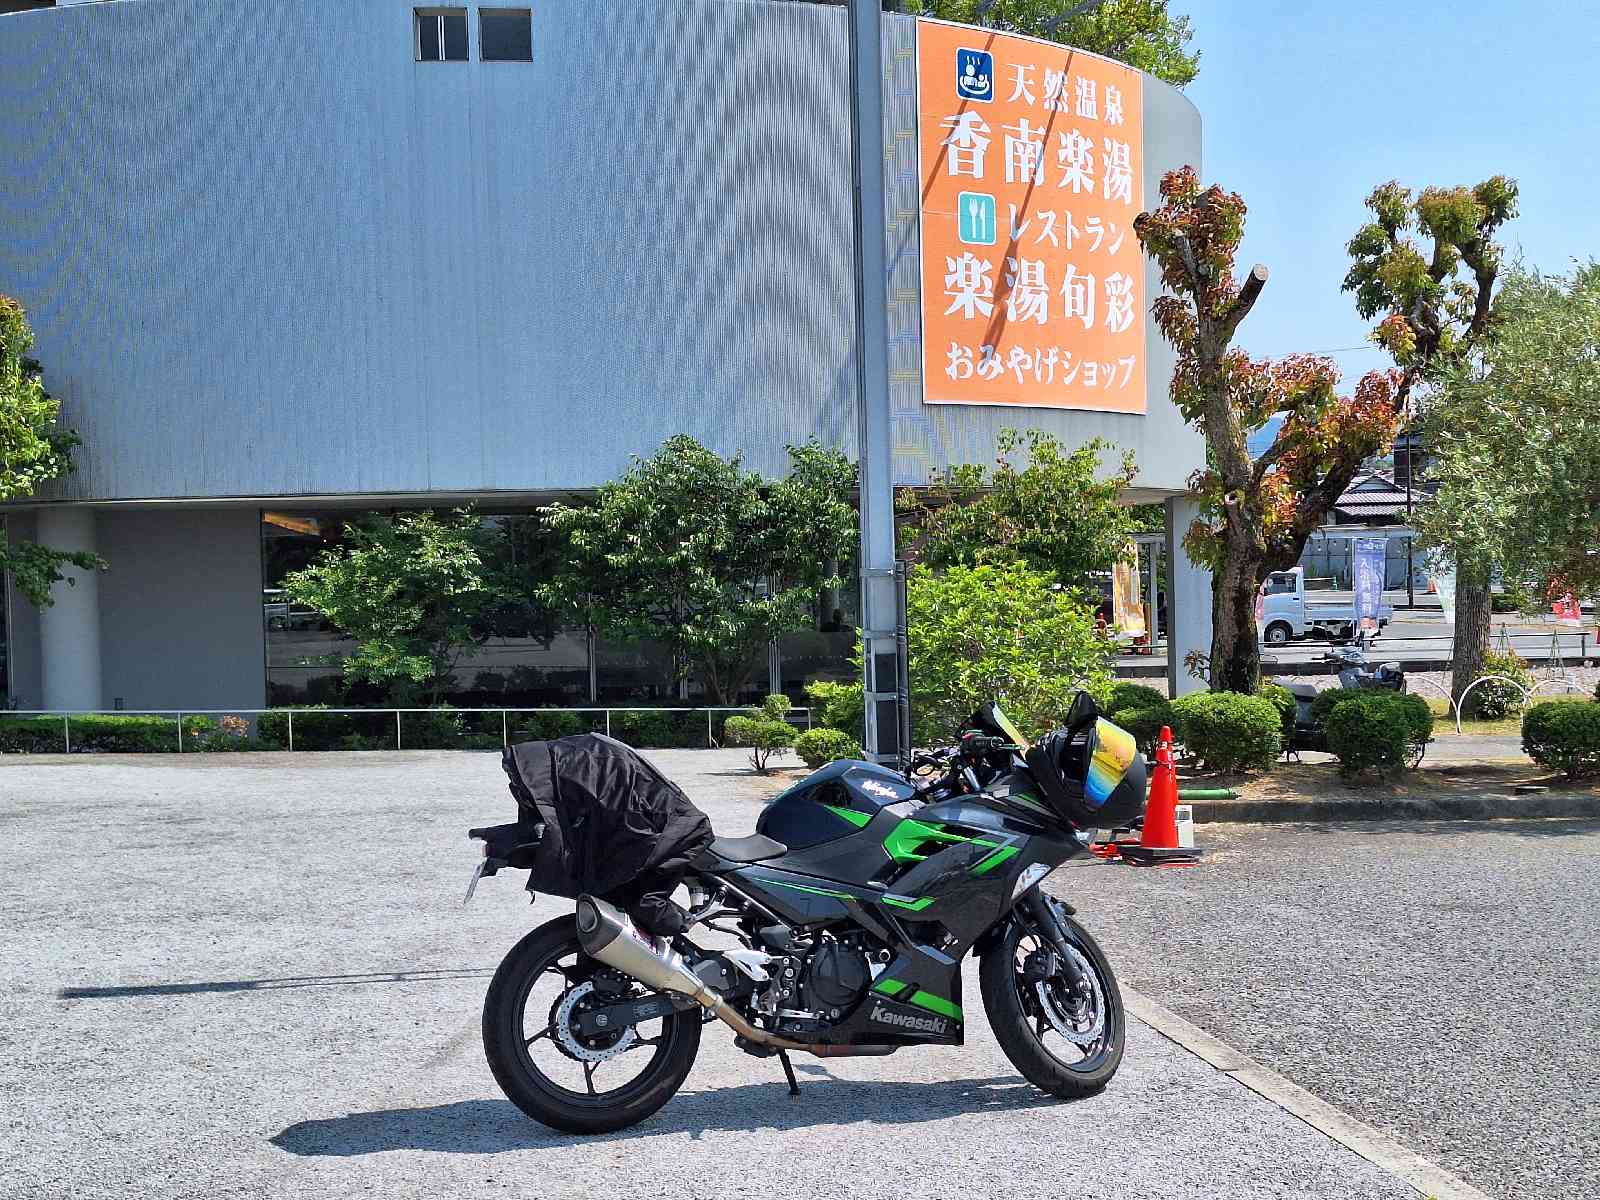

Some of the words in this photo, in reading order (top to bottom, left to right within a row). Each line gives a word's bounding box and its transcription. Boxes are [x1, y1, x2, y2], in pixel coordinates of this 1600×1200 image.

[1006, 63, 1124, 127] 天然温泉
[938, 110, 1133, 205] 香南楽湯
[1007, 203, 1125, 256] レストラン
[943, 252, 1135, 333] 楽湯旬彩
[944, 342, 1136, 389] おみやげショップ
[870, 1006, 947, 1033] Kawasaki
